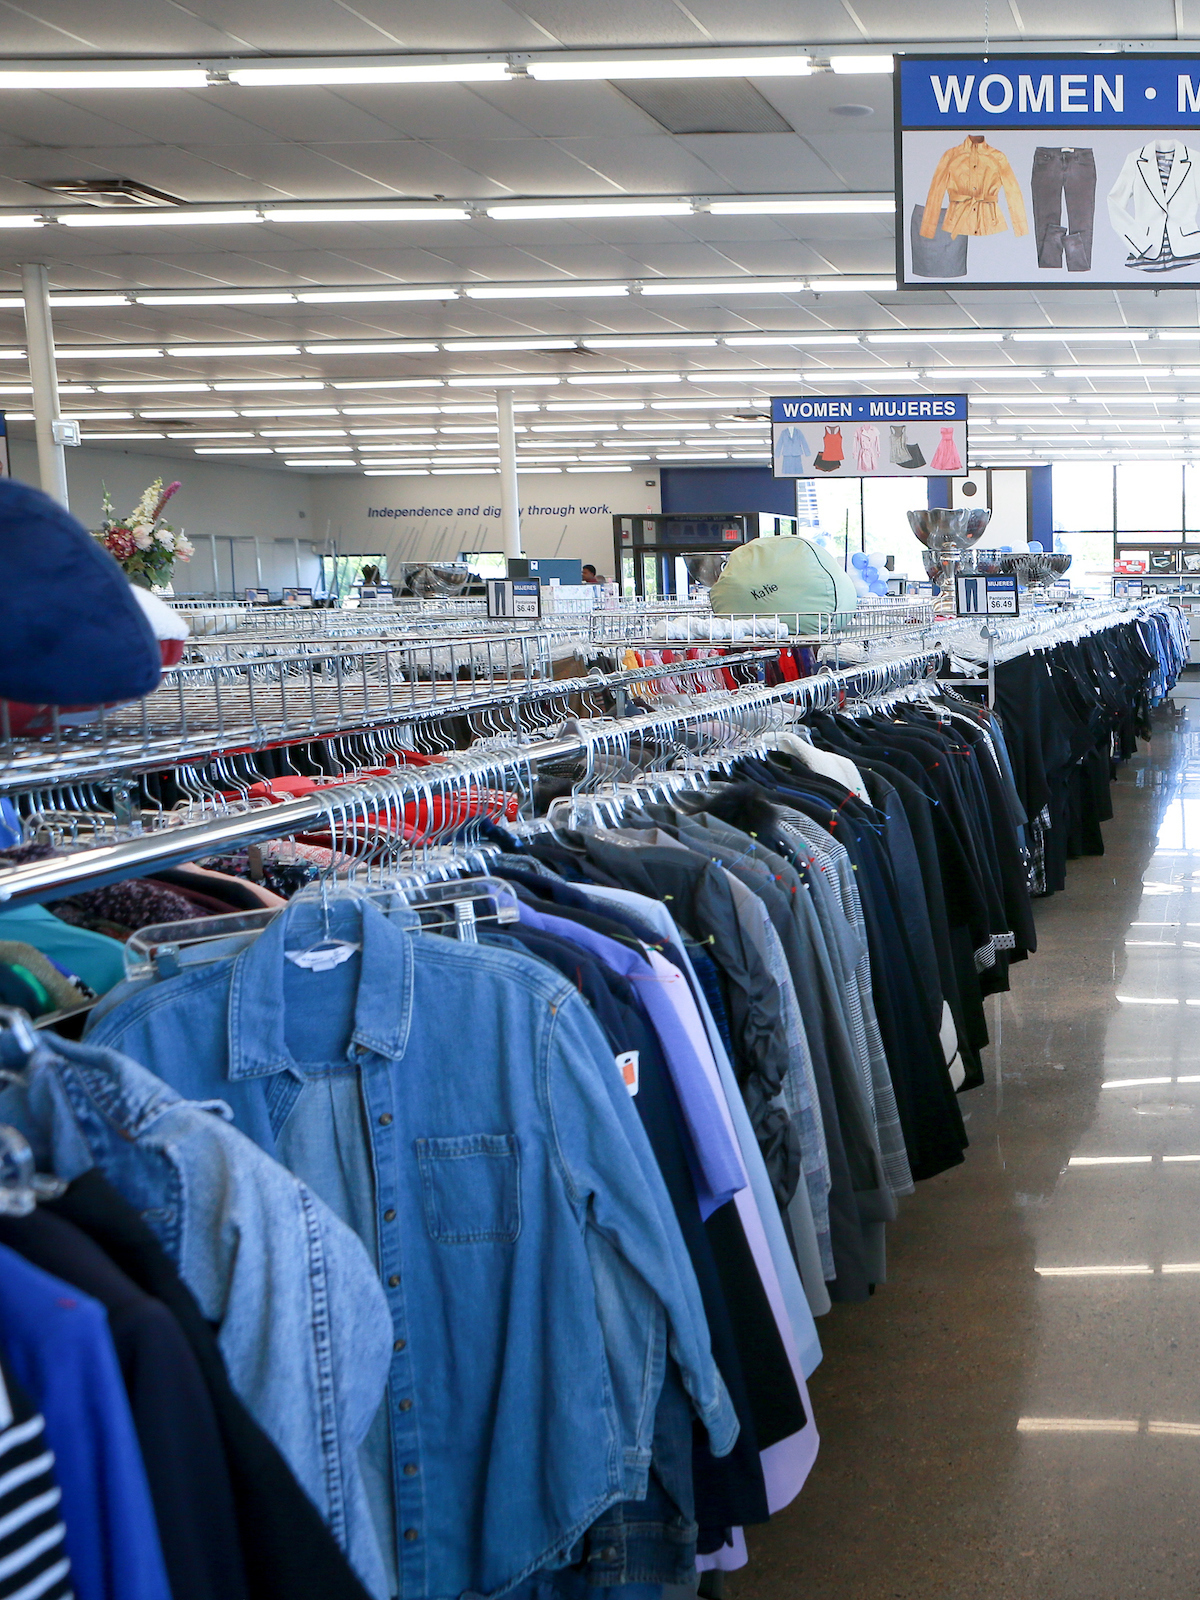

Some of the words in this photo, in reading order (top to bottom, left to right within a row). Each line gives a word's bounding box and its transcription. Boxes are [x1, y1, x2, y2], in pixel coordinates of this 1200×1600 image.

[929, 73, 1125, 115] WOMEN
[783, 402, 852, 418] WOMEN
[869, 401, 957, 416] MUJERES
[367, 506, 454, 519] Independence
[456, 505, 480, 516] and
[482, 505, 525, 519] digy
[527, 504, 576, 517] through
[578, 504, 613, 515] work.
[725, 530, 738, 540] EXIT
[750, 583, 779, 601] Katie
[516, 604, 536, 613] $6.49
[991, 600, 1013, 609] $6.49
